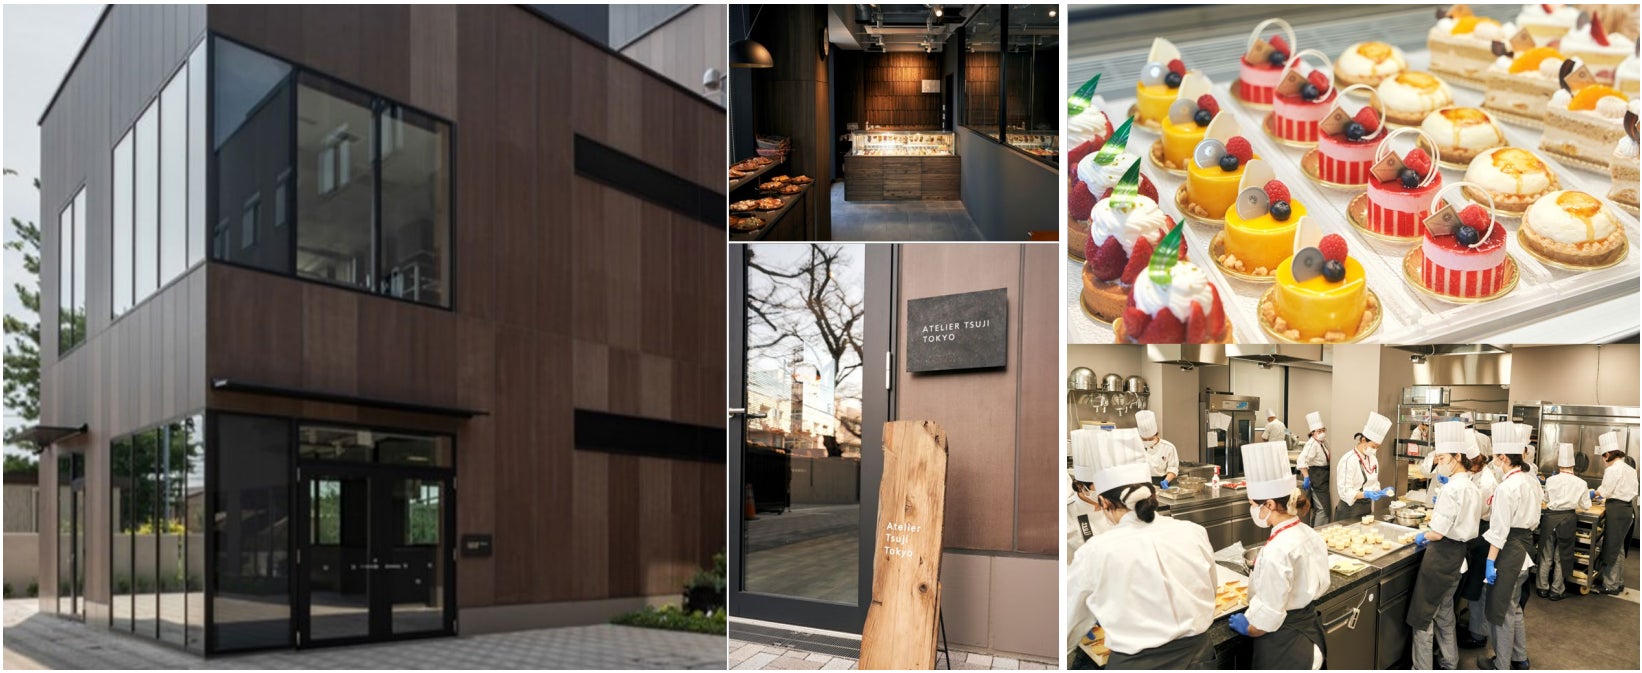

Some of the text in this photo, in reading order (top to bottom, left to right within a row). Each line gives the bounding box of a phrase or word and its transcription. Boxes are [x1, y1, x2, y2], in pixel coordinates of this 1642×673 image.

[922, 320, 990, 333] ATELIER TSUJI
[922, 333, 955, 343] TOKYO
[886, 522, 921, 533] Atelier
[885, 533, 908, 545] Tsuji
[884, 545, 913, 558] Tokyo
